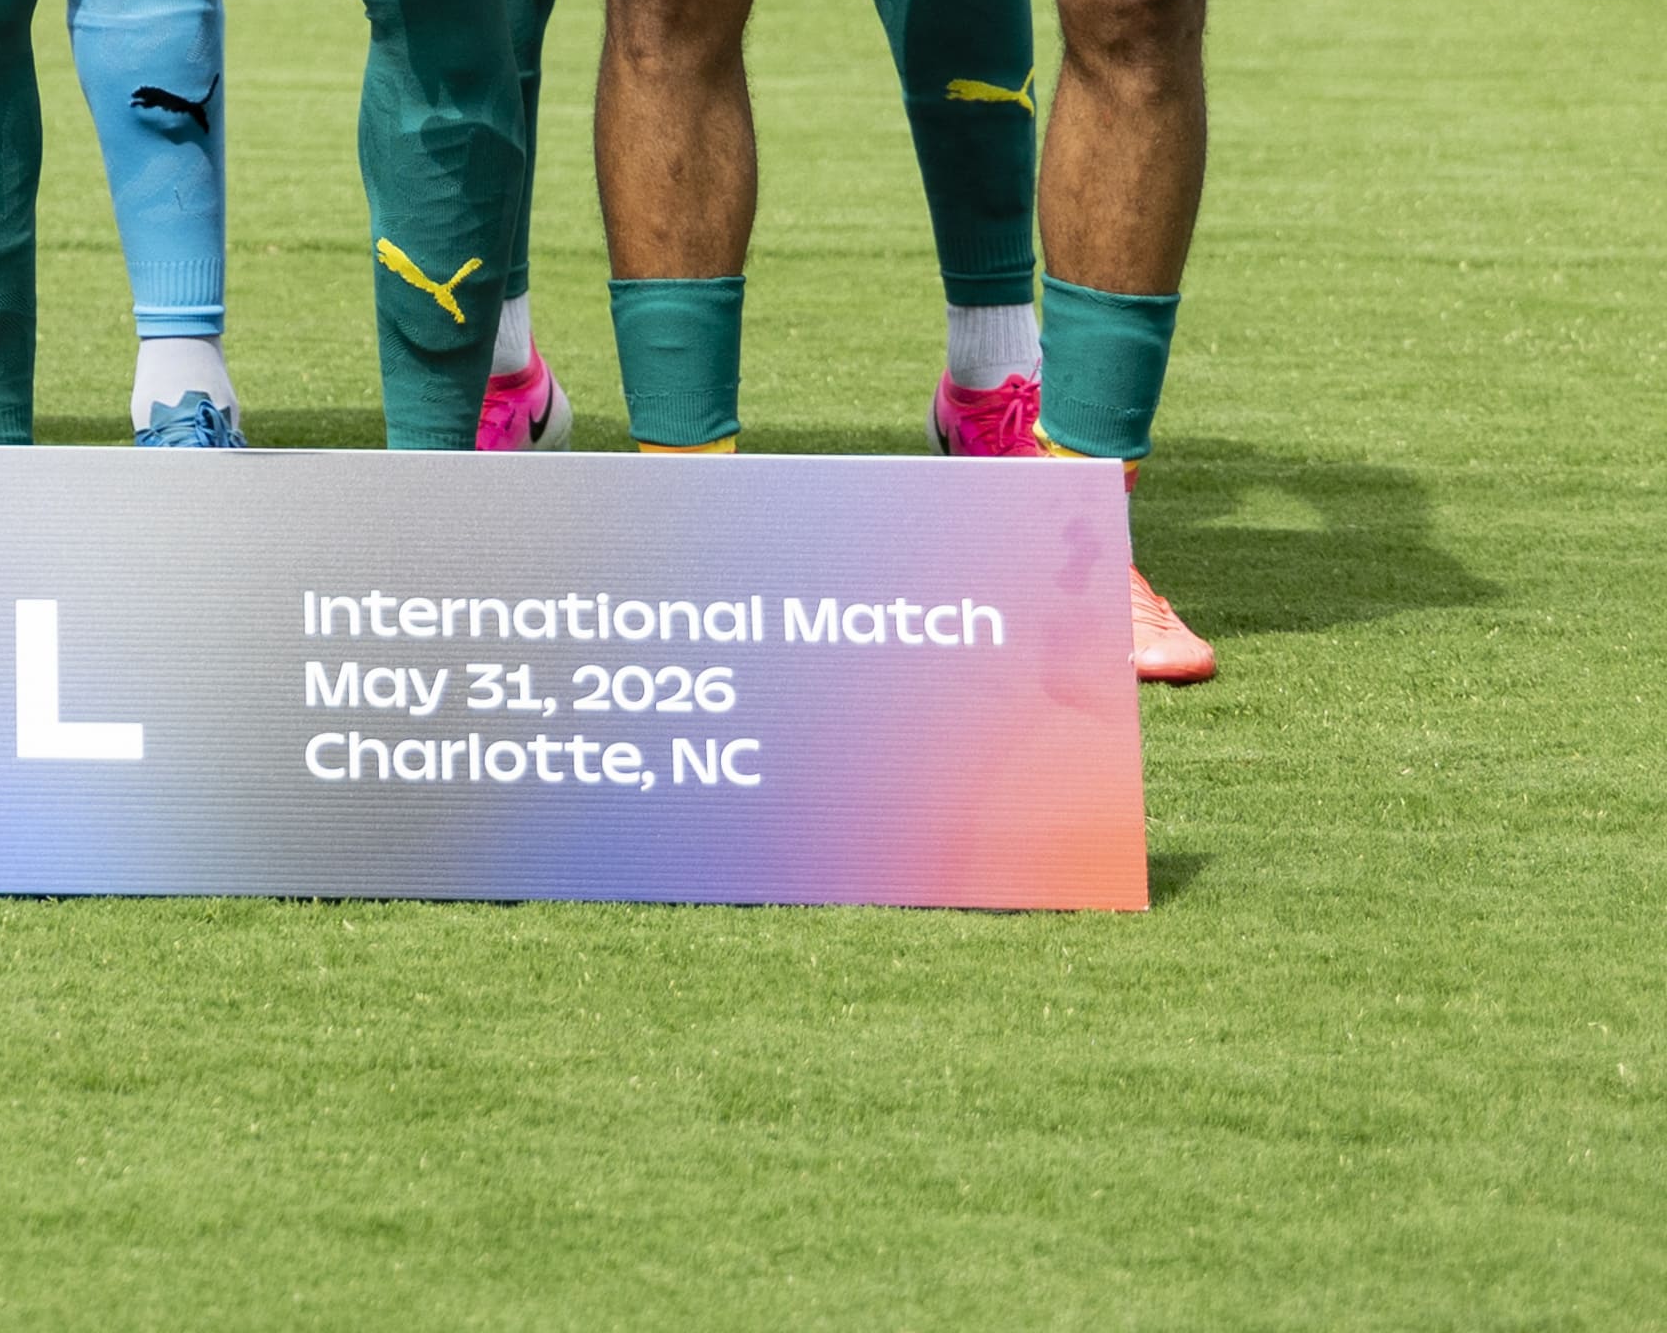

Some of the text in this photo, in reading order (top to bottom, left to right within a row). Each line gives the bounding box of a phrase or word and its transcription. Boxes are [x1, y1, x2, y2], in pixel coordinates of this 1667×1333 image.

[303, 589, 1005, 646] International Match
[304, 660, 737, 718] May 31, 2026
[304, 731, 762, 790] Charlotte, NC
